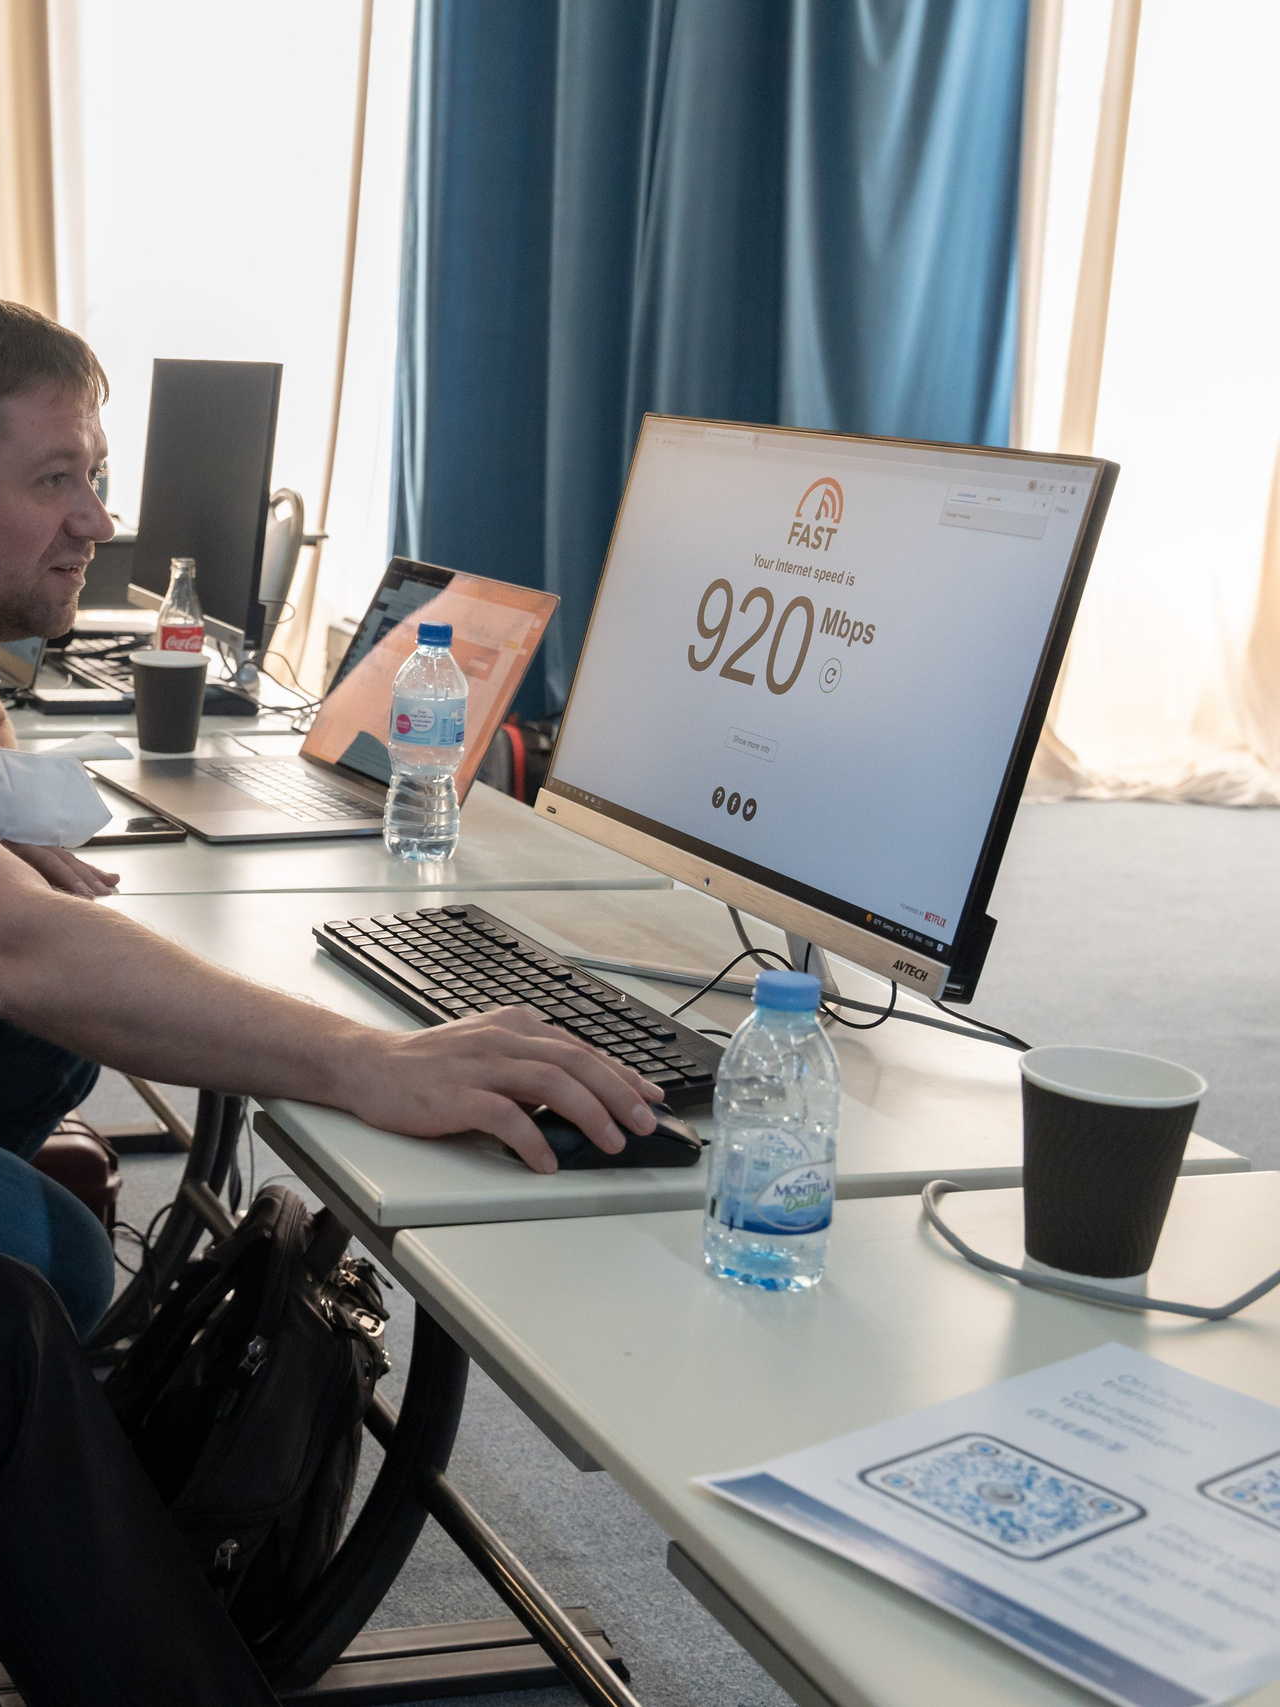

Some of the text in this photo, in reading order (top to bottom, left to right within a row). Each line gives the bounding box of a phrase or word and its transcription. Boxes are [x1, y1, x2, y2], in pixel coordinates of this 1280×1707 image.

[787, 521, 838, 552] FAST
[753, 553, 856, 587] Your Internet speed is
[688, 577, 875, 696] 920 Mbps
[733, 735, 770, 753] Show more info
[924, 911, 946, 928] NETFLIX
[892, 960, 928, 981] AVTECH
